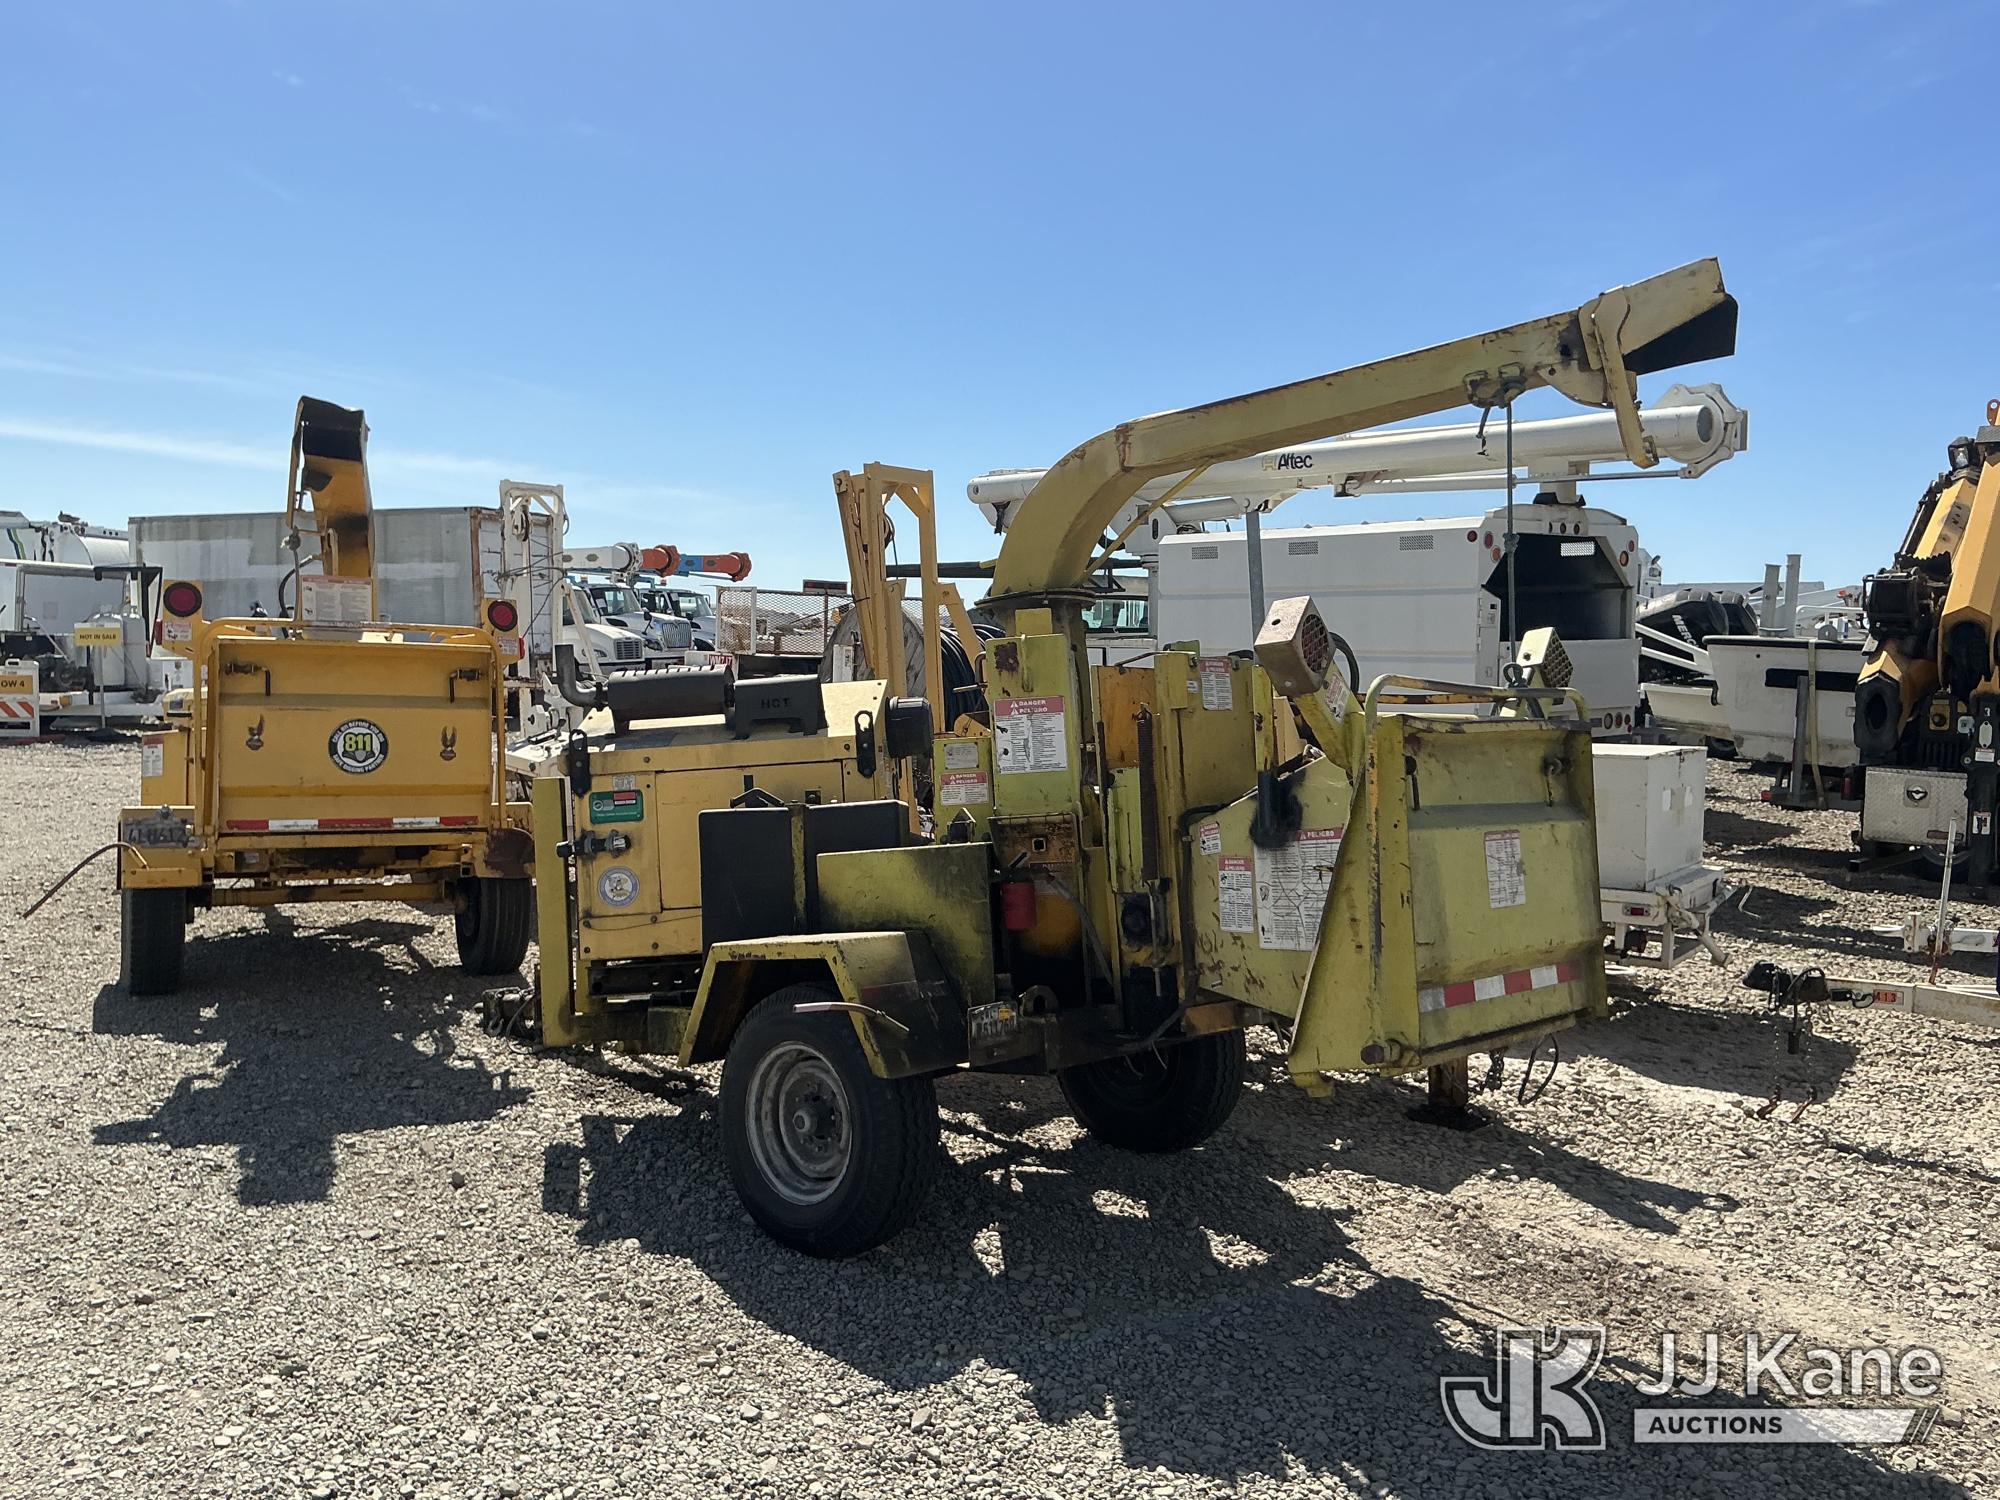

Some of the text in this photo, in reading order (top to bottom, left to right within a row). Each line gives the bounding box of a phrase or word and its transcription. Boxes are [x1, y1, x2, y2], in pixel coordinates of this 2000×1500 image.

[1278, 454, 1313, 470] Altec
[1672, 614, 1699, 648] MERC
[0, 680, 25, 688] OW 4
[761, 697, 791, 709] HOT
[1019, 699, 1047, 707] DANGER
[1984, 707, 1991, 717] 3
[344, 733, 372, 752] 811
